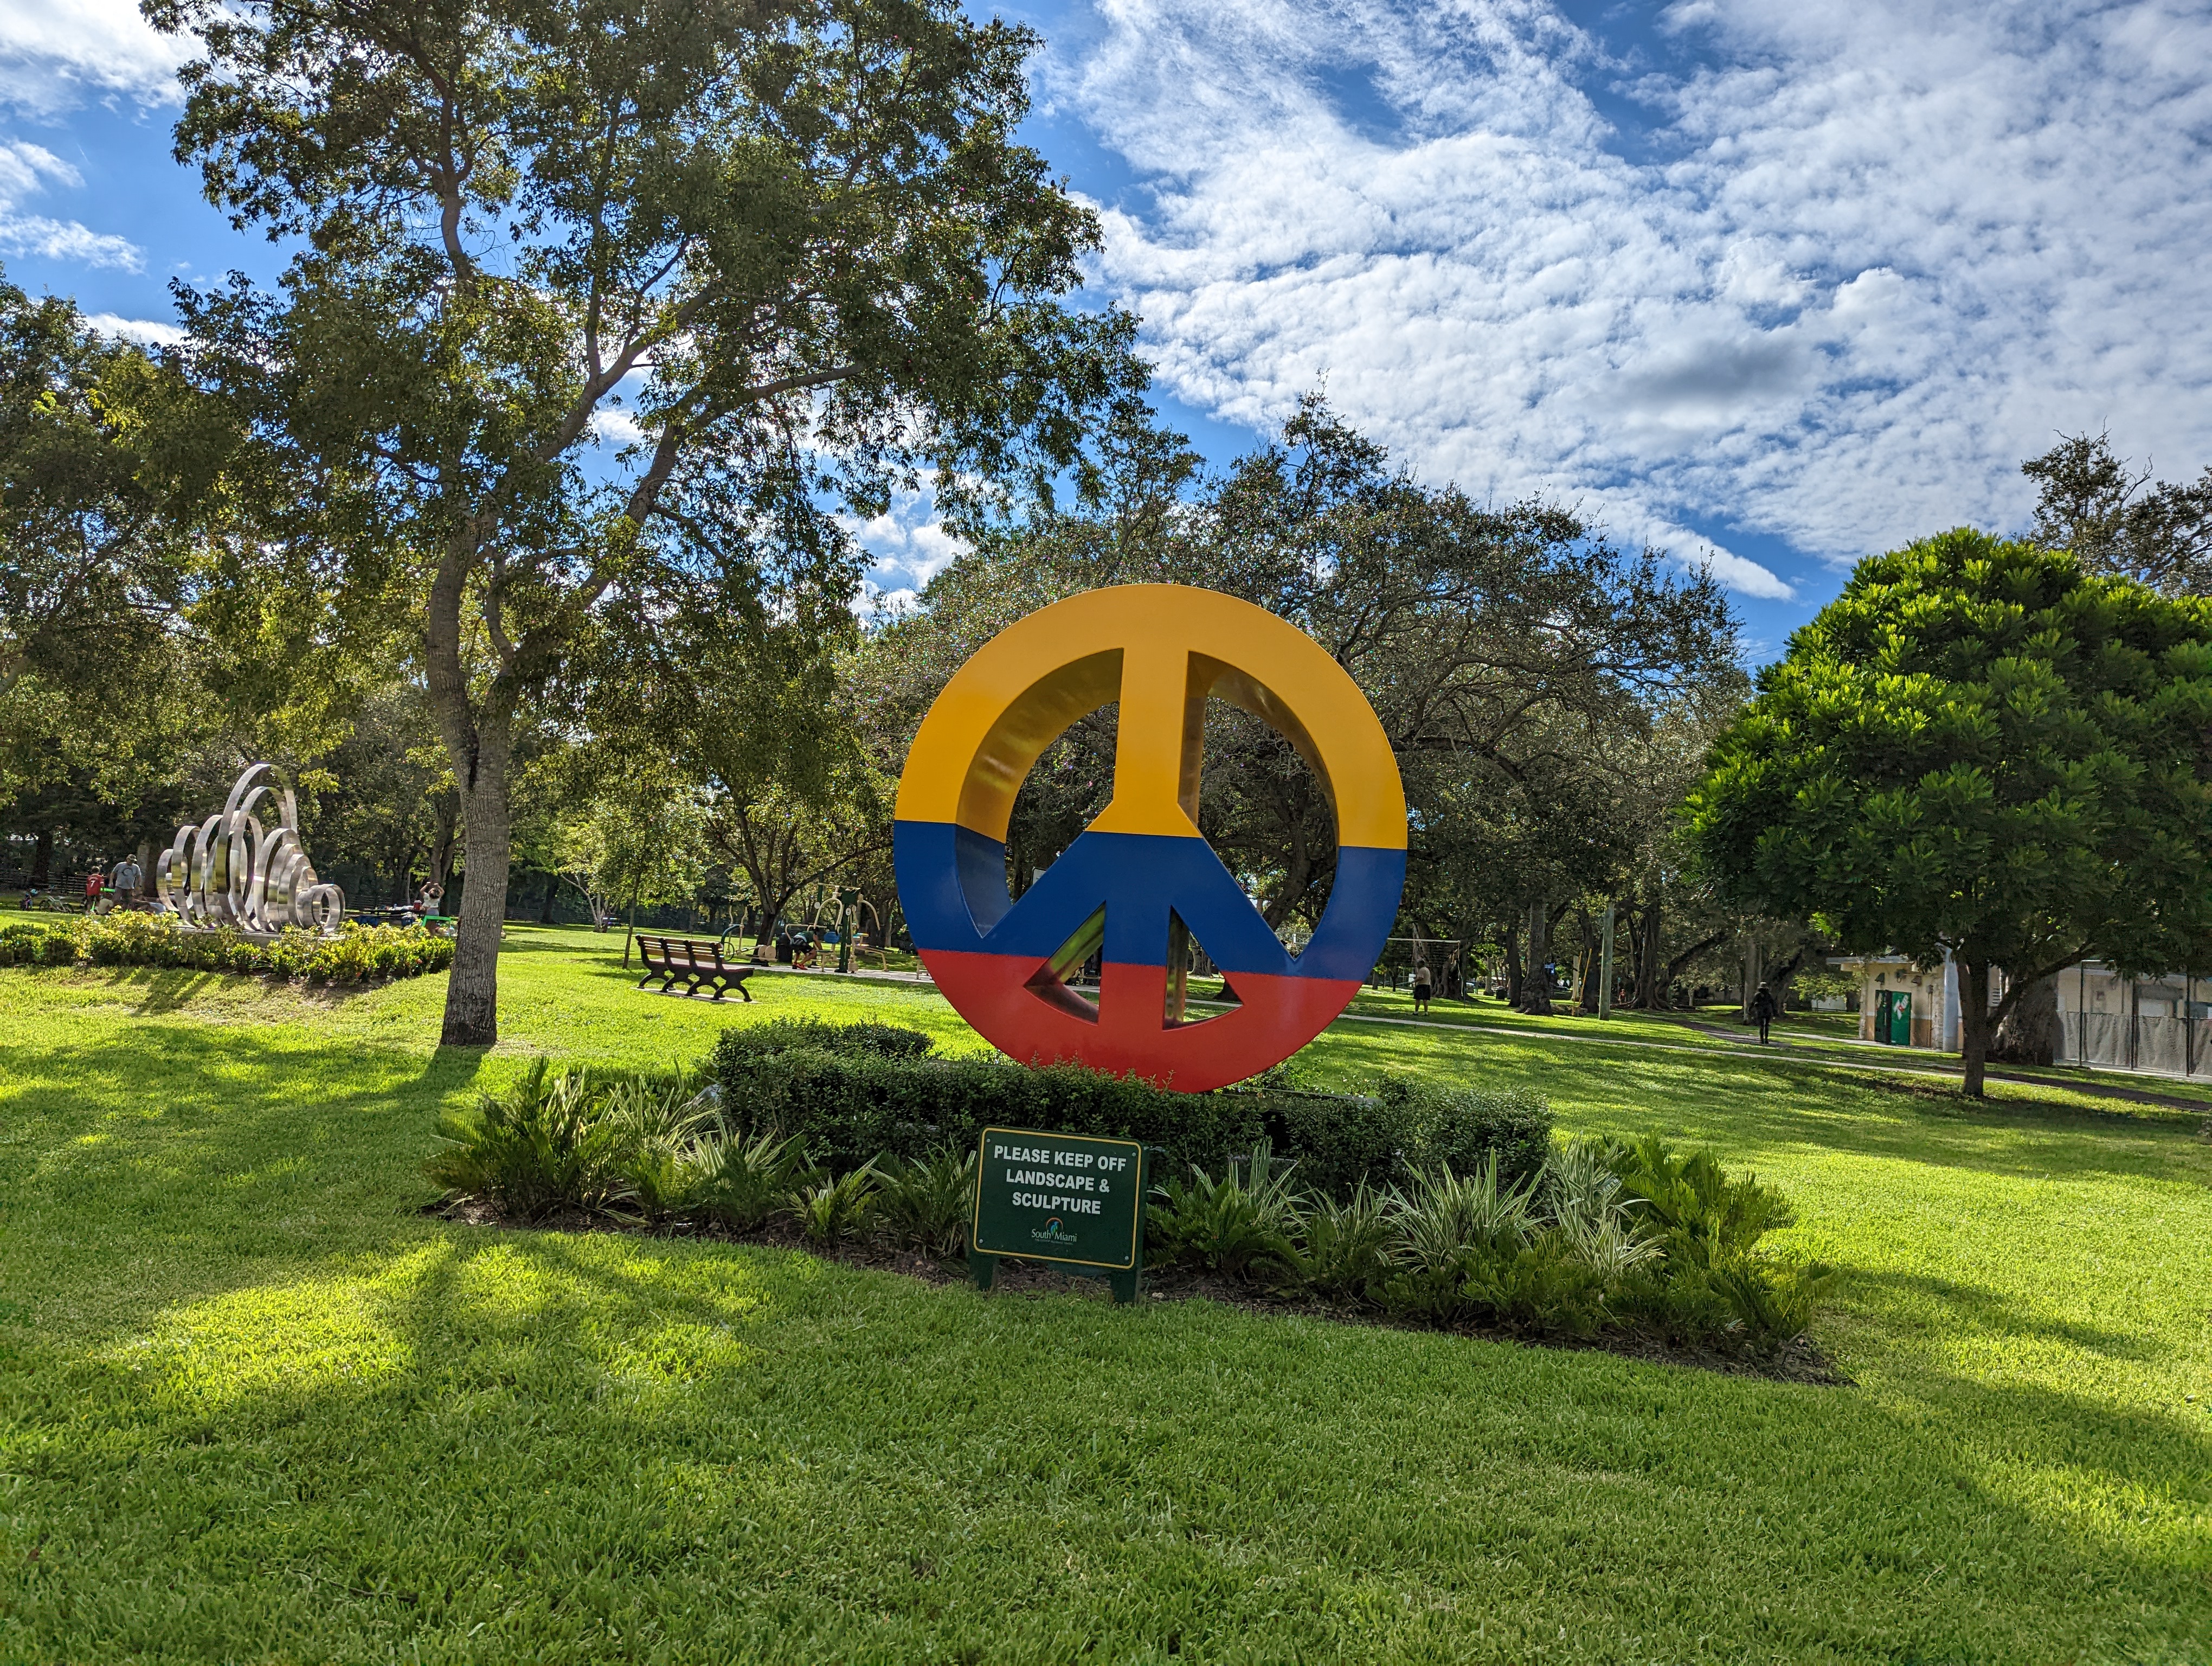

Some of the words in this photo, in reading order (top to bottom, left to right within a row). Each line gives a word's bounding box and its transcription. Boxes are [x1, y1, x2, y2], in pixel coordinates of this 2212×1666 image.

[994, 1145, 1050, 1164] PLEASE
[1054, 1151, 1094, 1168] KEEP
[1097, 1156, 1127, 1171] OFF
[1006, 1169, 1095, 1191] LANDSCAPE
[1099, 1178, 1110, 1193] &
[1012, 1191, 1101, 1215] SCULPTURE
[1031, 1228, 1051, 1239] South
[1054, 1231, 1077, 1242] Miami
